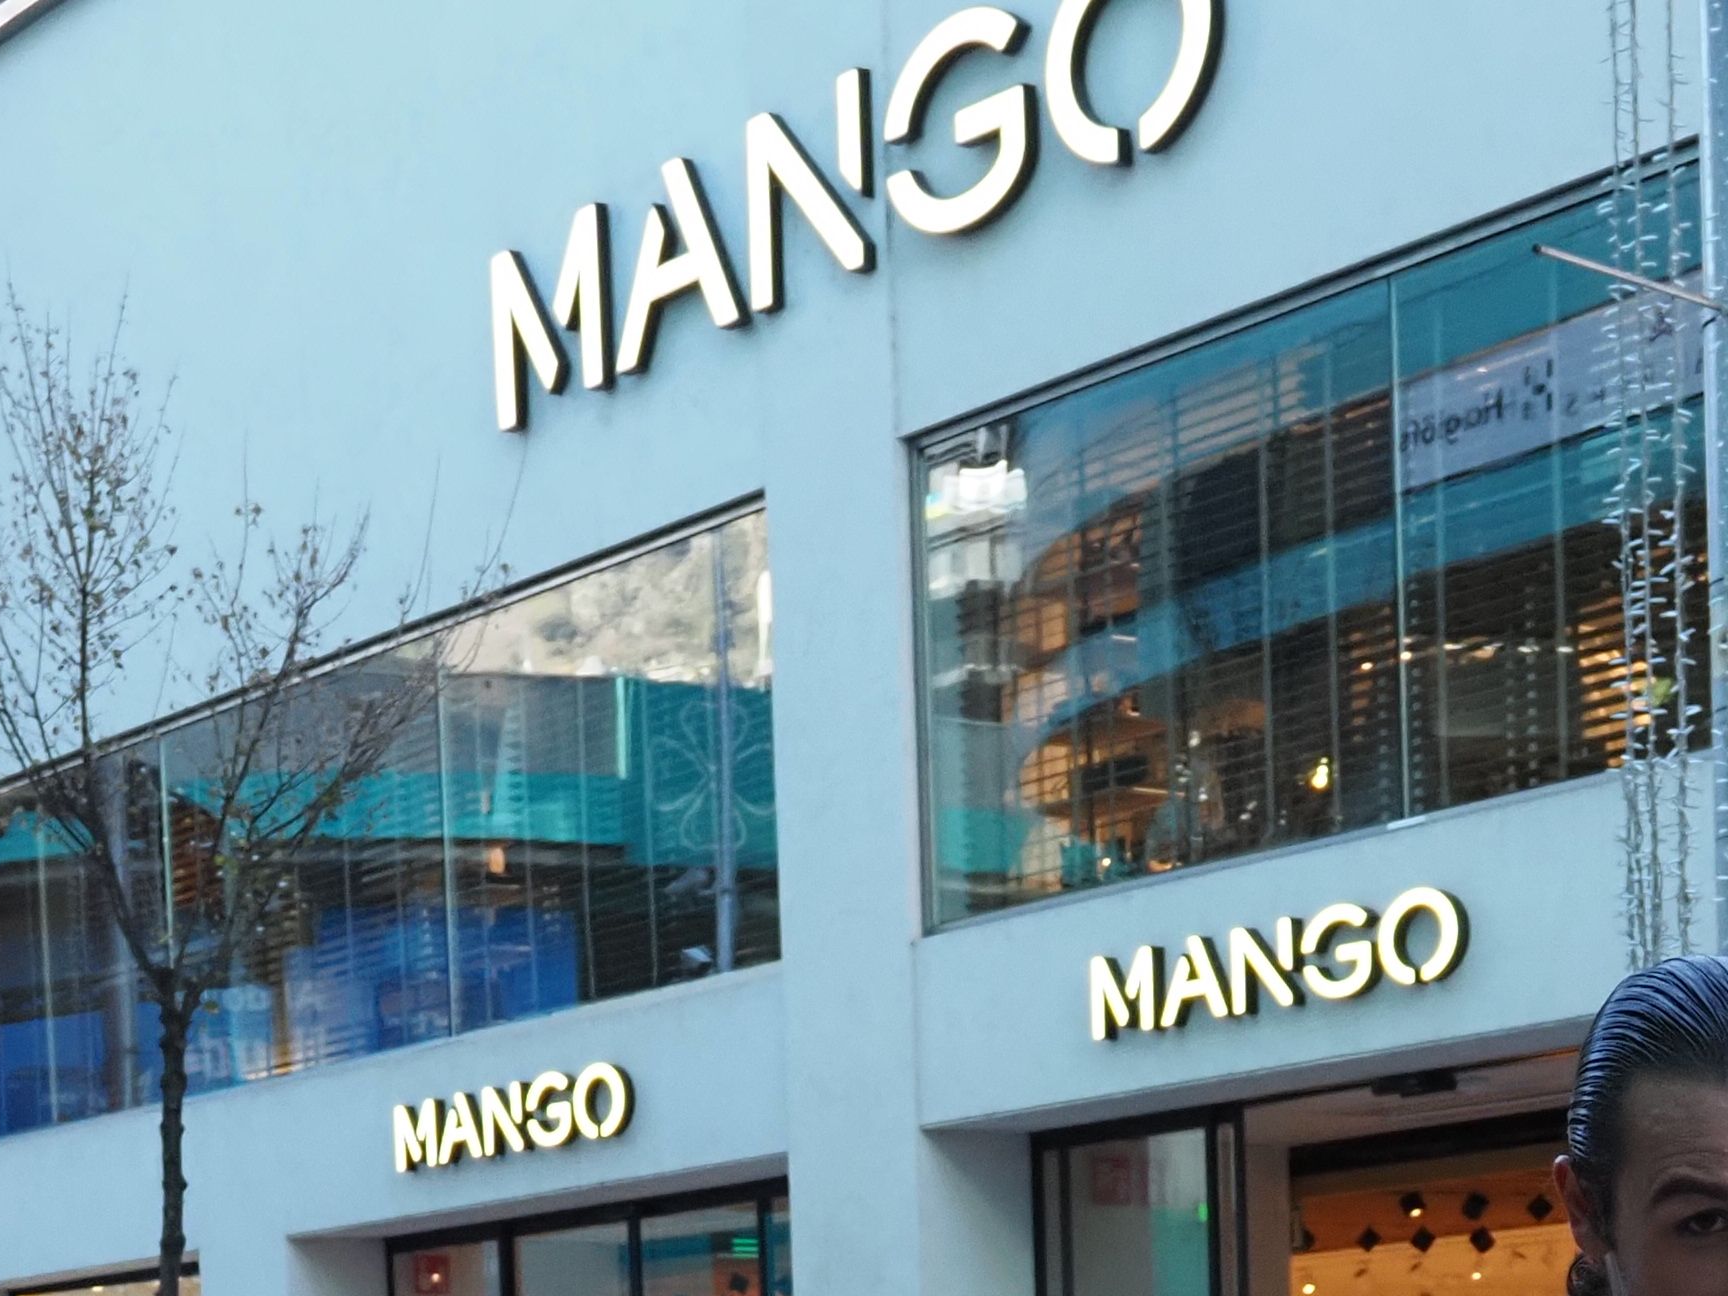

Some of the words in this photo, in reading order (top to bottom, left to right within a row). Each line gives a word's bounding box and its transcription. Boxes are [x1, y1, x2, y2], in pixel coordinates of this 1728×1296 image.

[490, 0, 1224, 433] MANGO
[1087, 885, 1470, 1042] MANGO
[392, 1062, 634, 1176] MANGO
